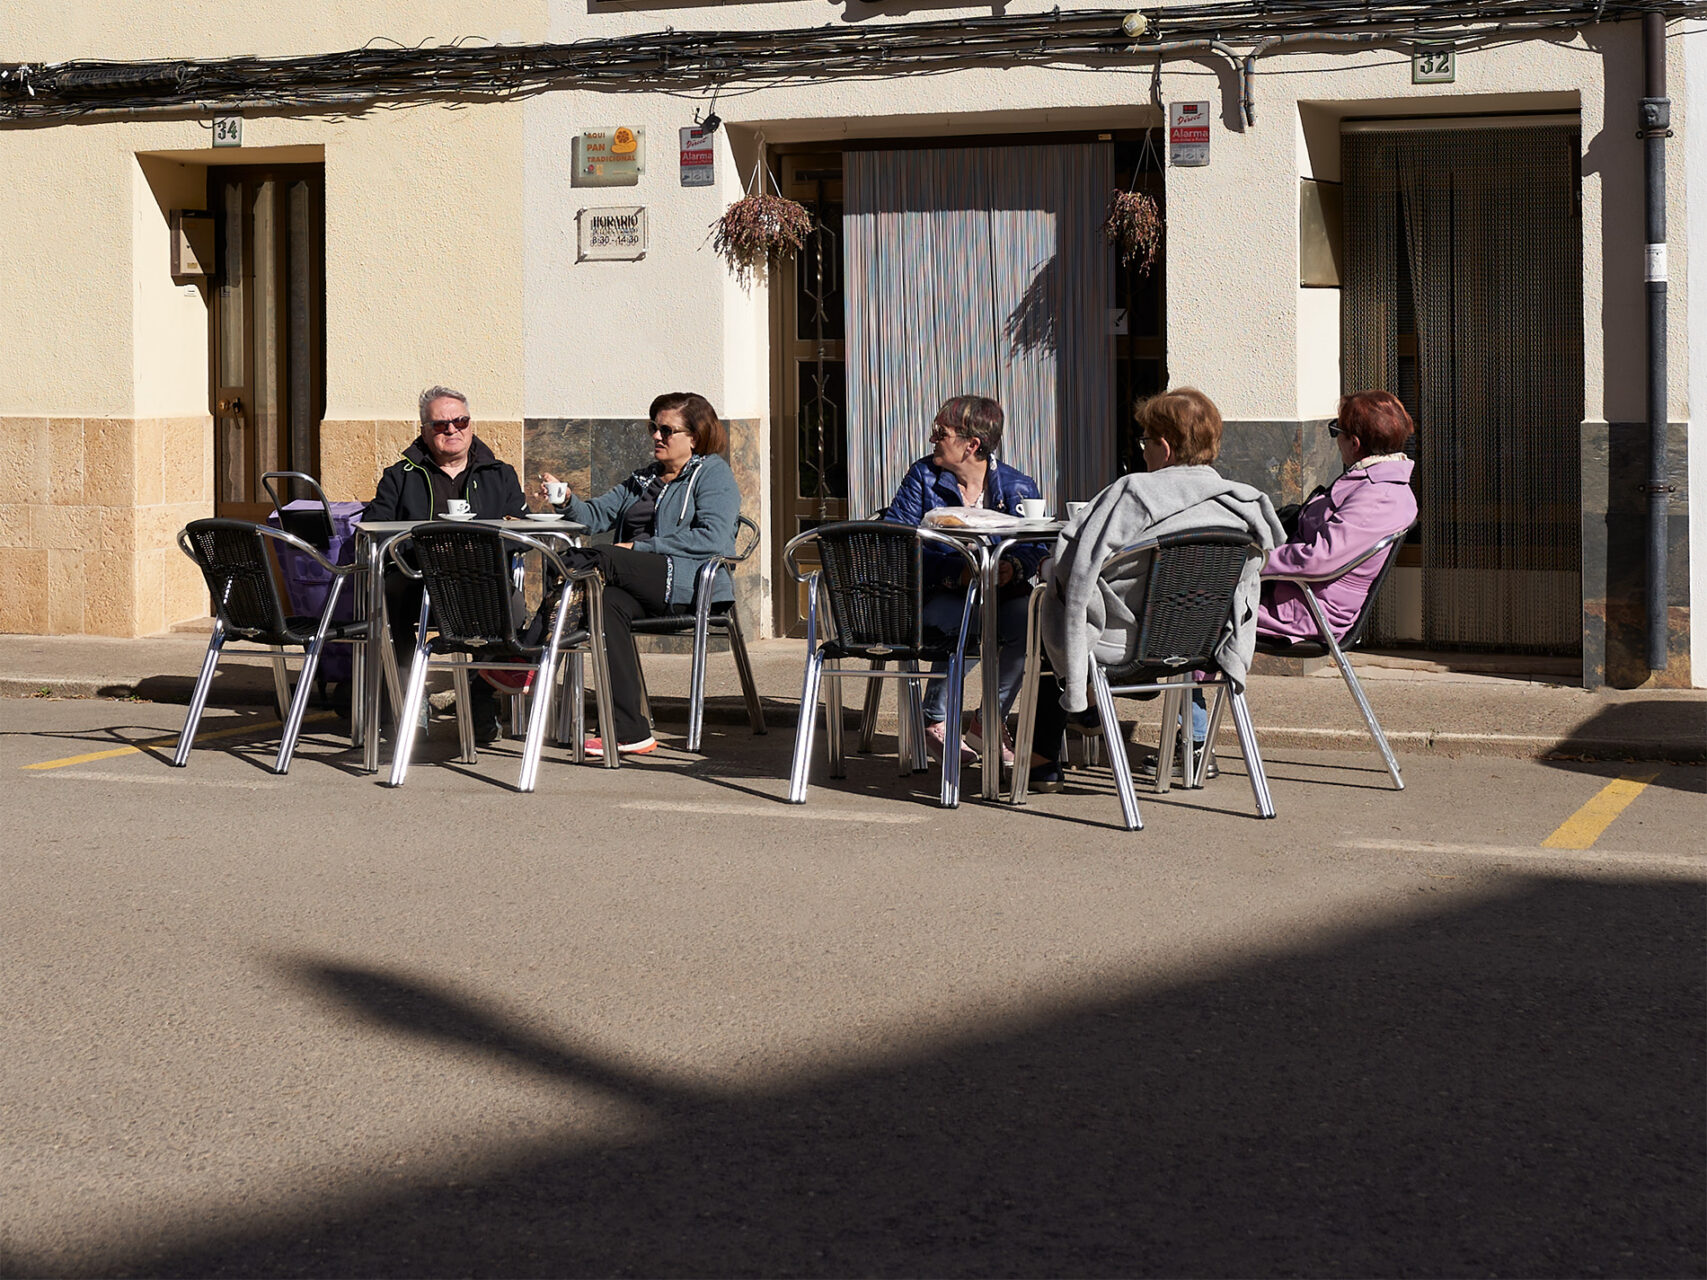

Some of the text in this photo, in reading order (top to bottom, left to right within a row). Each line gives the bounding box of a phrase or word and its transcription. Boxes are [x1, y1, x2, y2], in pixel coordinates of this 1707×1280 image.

[1420, 51, 1449, 74] 32
[218, 120, 238, 140] 34
[1173, 128, 1208, 138] Alarma
[587, 155, 636, 163] TRADICIONAL
